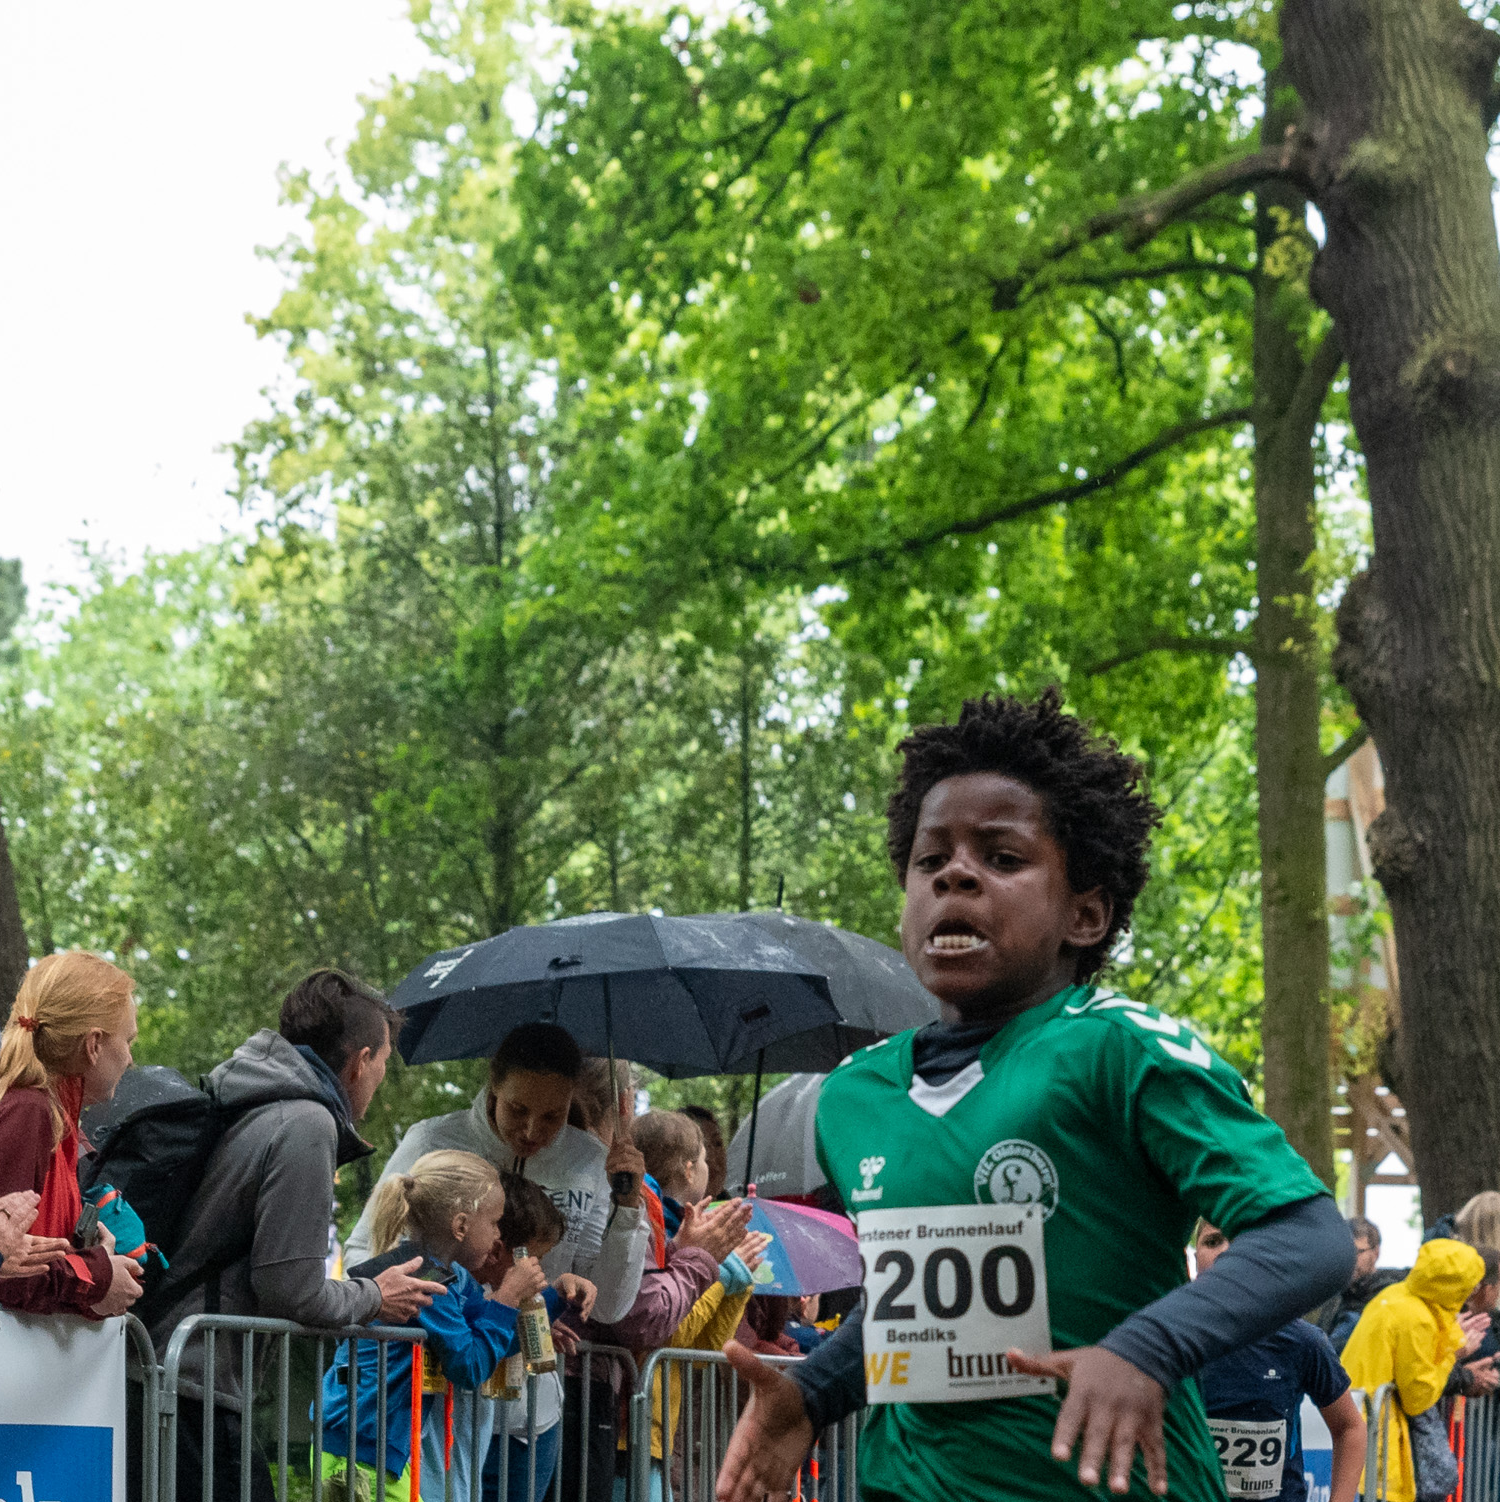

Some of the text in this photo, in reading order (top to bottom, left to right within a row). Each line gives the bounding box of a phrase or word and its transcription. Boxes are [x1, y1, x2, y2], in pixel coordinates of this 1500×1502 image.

[859, 1220, 1024, 1243] rstener Brunnenlauf
[860, 1244, 1036, 1322] 200
[886, 1328, 957, 1343] Bendiks
[864, 1351, 911, 1386] WE
[947, 1346, 1016, 1378] brun
[1240, 1477, 1275, 1491] bruns
